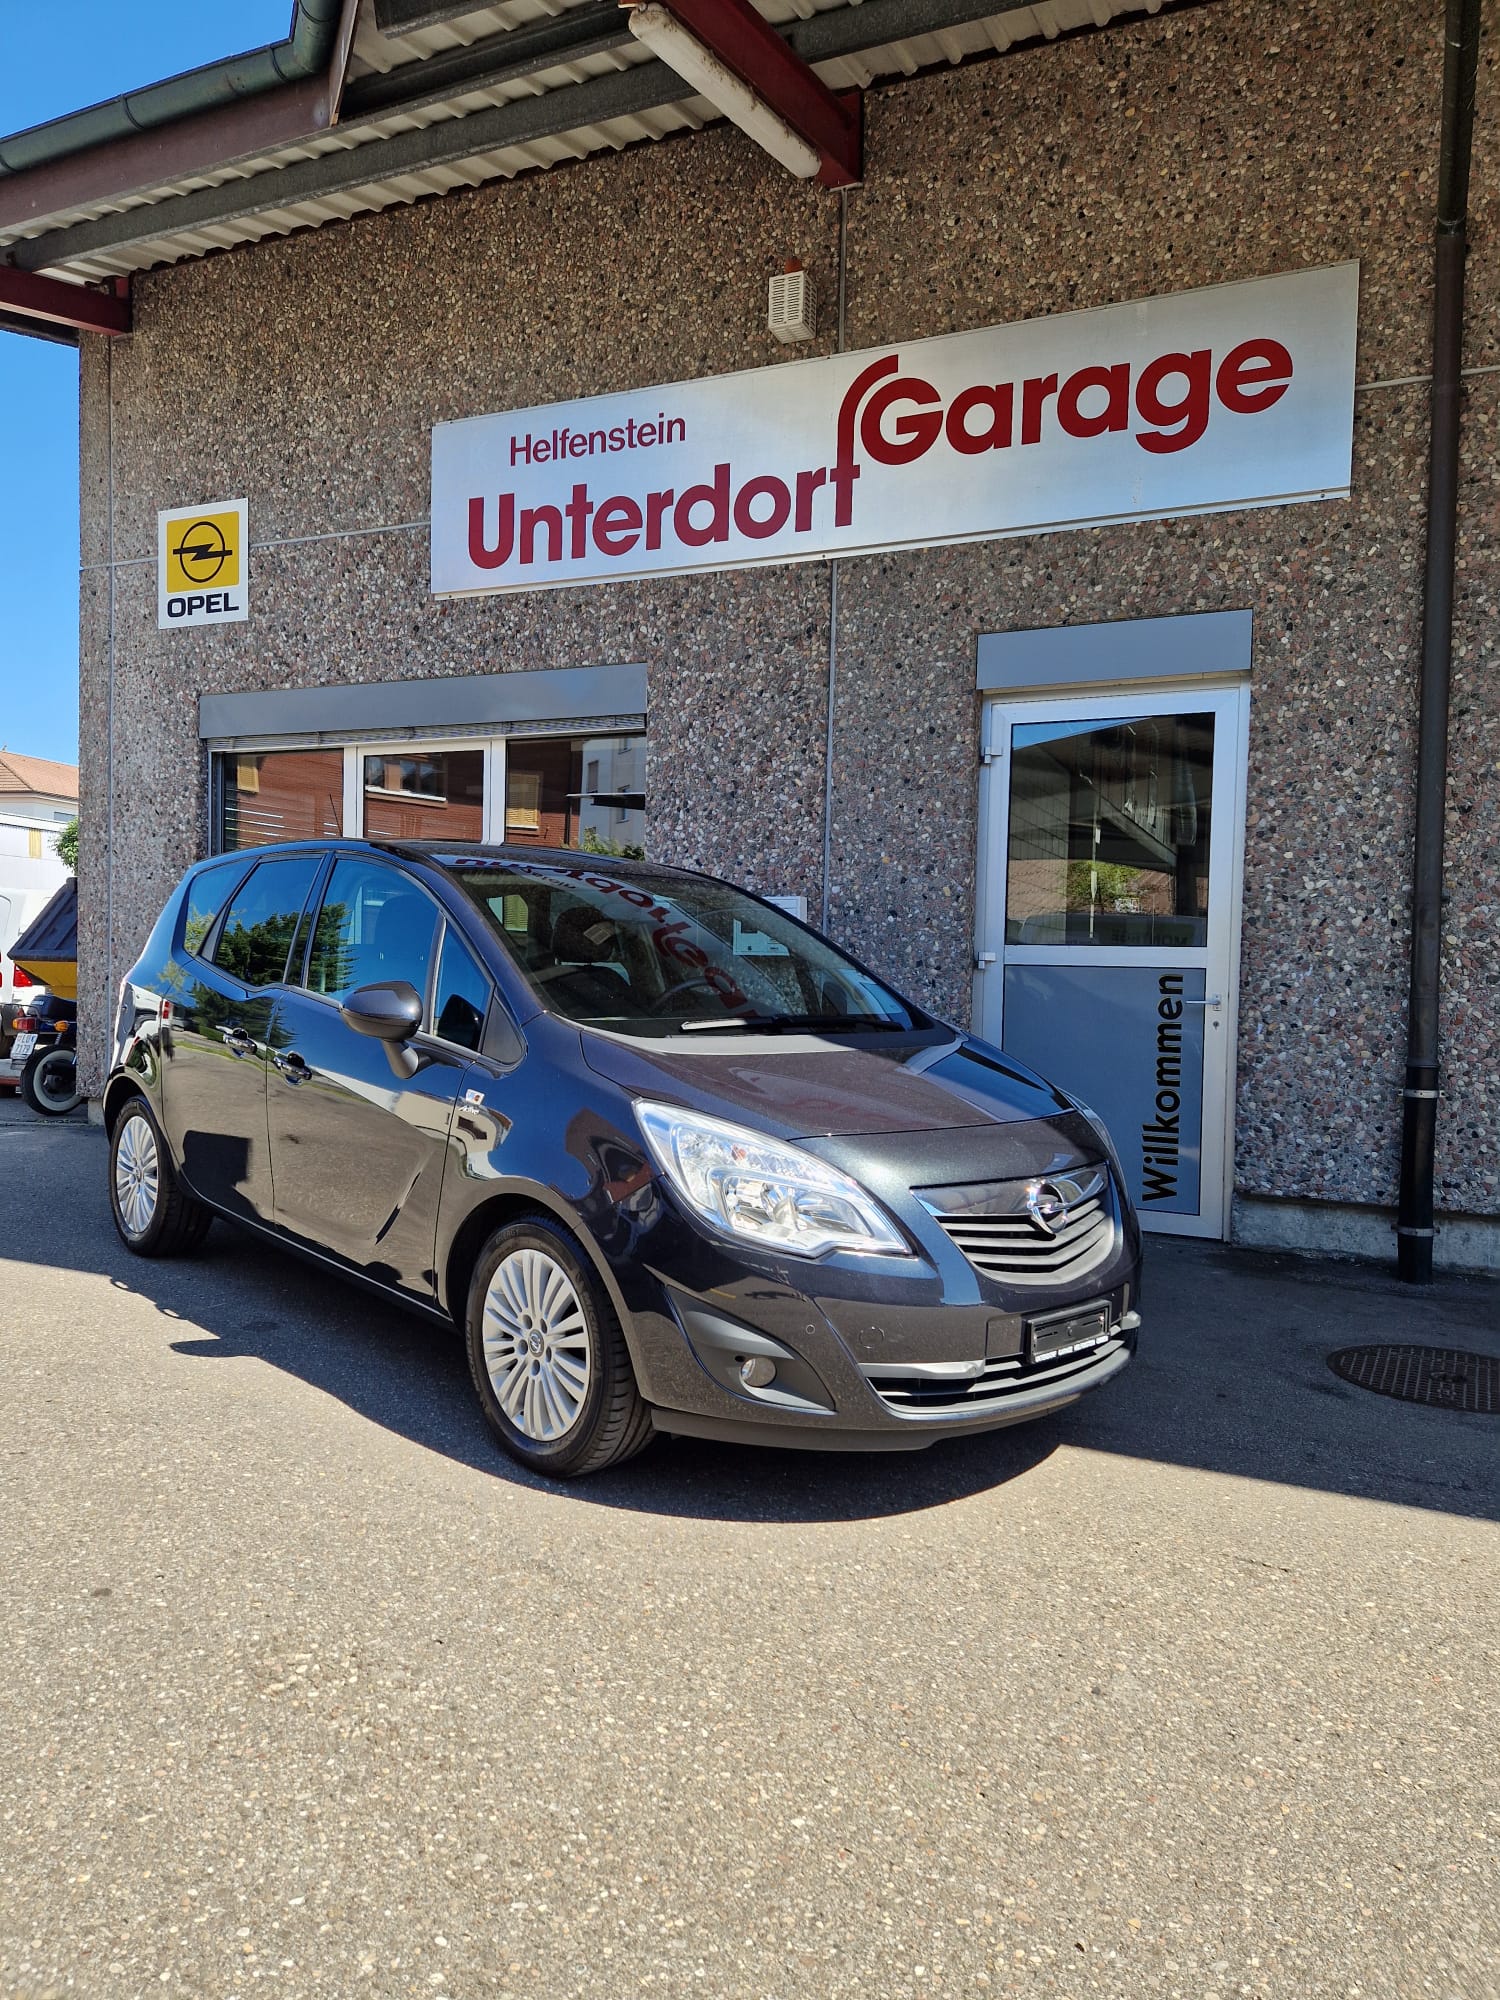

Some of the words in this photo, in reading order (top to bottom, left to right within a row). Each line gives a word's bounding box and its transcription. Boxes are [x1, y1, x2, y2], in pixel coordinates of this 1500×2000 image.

[468, 354, 898, 569] Unterdorf
[860, 338, 1292, 466] Garage
[509, 412, 686, 467] Helfenstein
[167, 592, 240, 618] OPEL
[1142, 974, 1184, 1201] Willkommen
